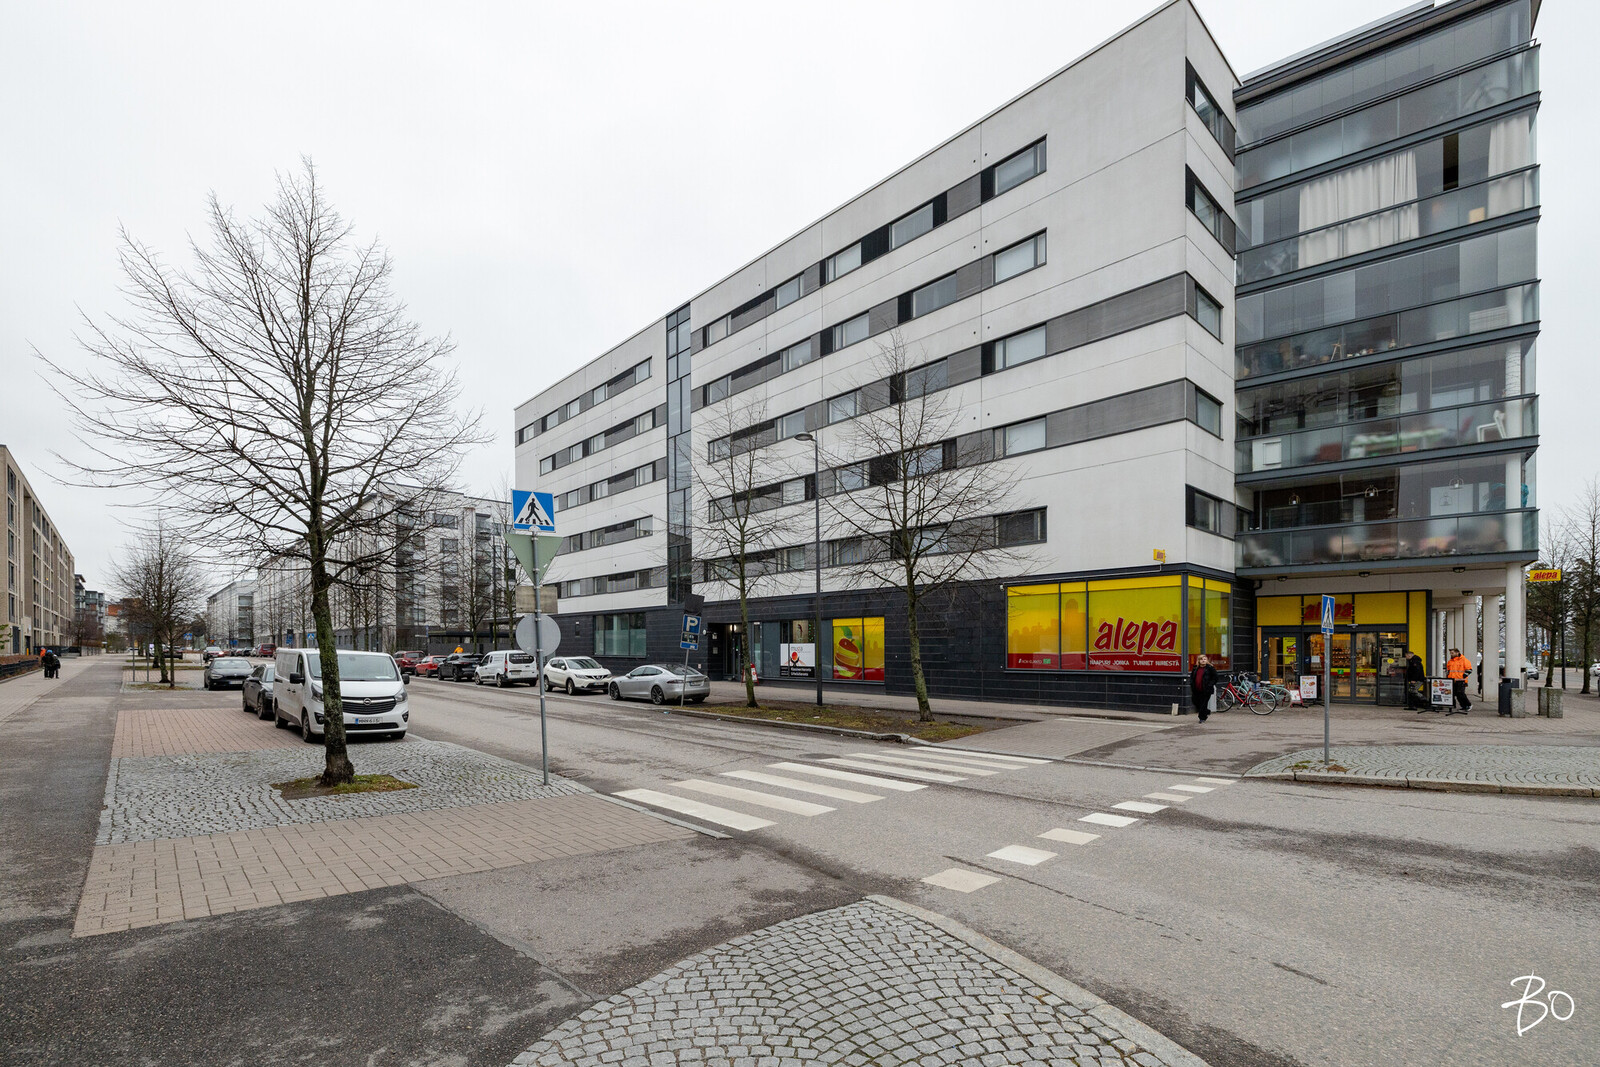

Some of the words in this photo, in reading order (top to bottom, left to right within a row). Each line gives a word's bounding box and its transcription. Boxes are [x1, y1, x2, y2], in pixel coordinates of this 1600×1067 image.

[1533, 571, 1558, 580] alepa
[686, 617, 698, 632] P
[1094, 617, 1178, 657] alepa
